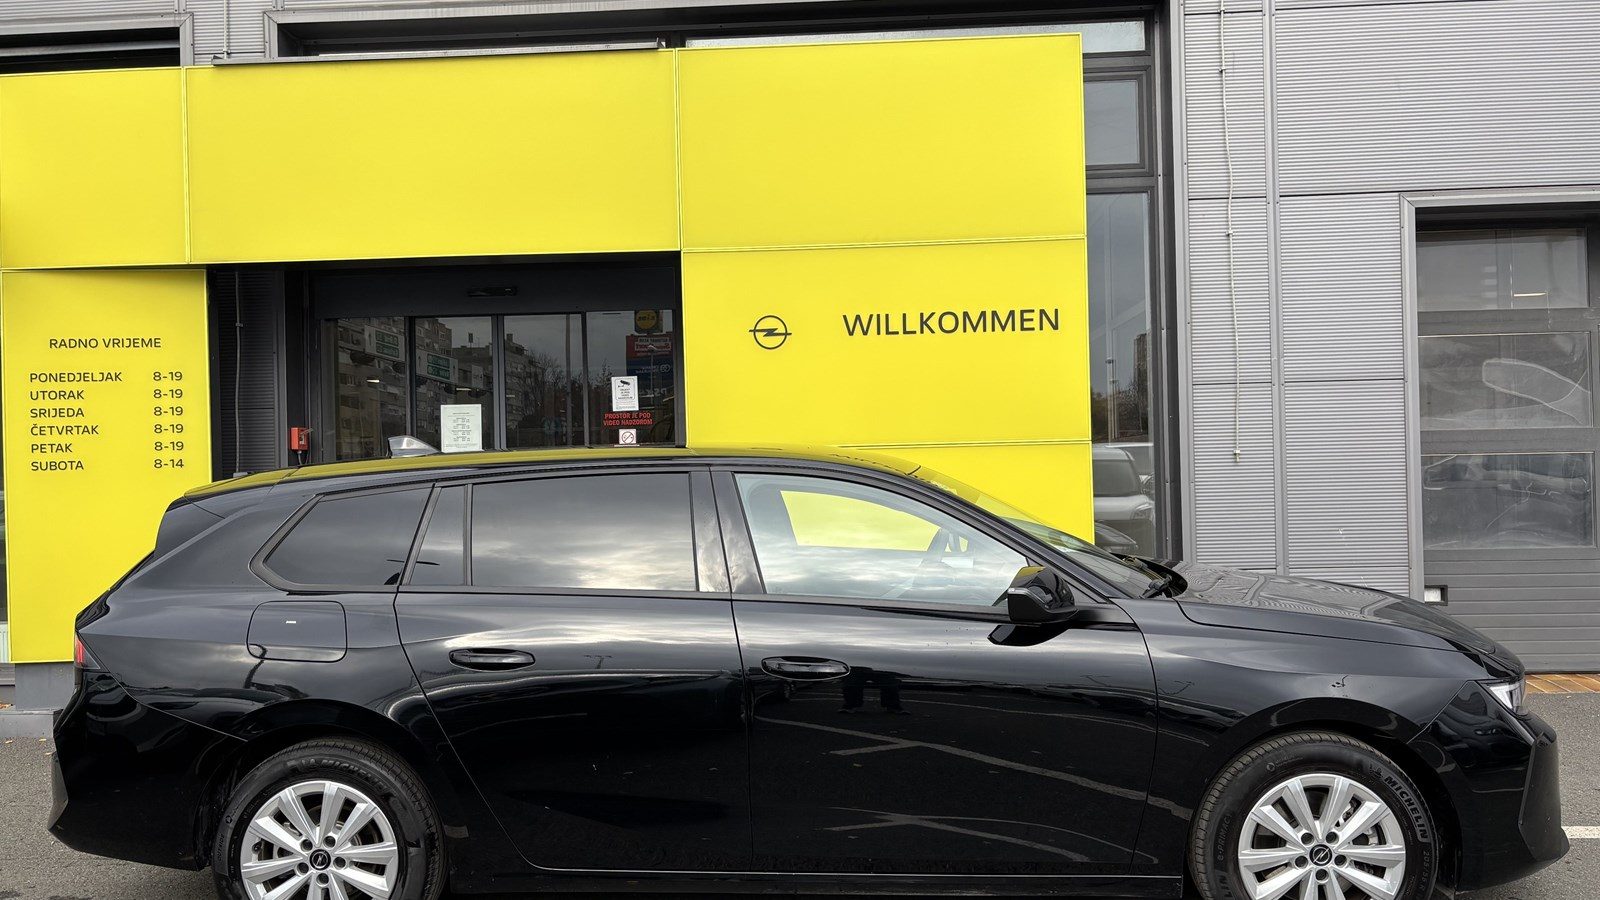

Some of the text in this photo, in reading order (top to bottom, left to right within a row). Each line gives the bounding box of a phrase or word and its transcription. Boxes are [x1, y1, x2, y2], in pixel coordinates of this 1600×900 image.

[843, 309, 1058, 336] WILLKOMMEN
[50, 338, 161, 348] RADNO VRIJEME
[30, 372, 182, 382] PONEDJELJAK 8-19
[30, 389, 183, 400] UTORAK 8-19
[30, 406, 183, 418] SRIJEDA 8-19
[621, 418, 653, 426] NADZOROM
[31, 424, 183, 436] ČETVRTAK 8-19
[32, 441, 183, 453] PETAK 8-19
[31, 459, 184, 471] SUBOTA 8-14
[1384, 775, 1429, 840] MICHELIN
